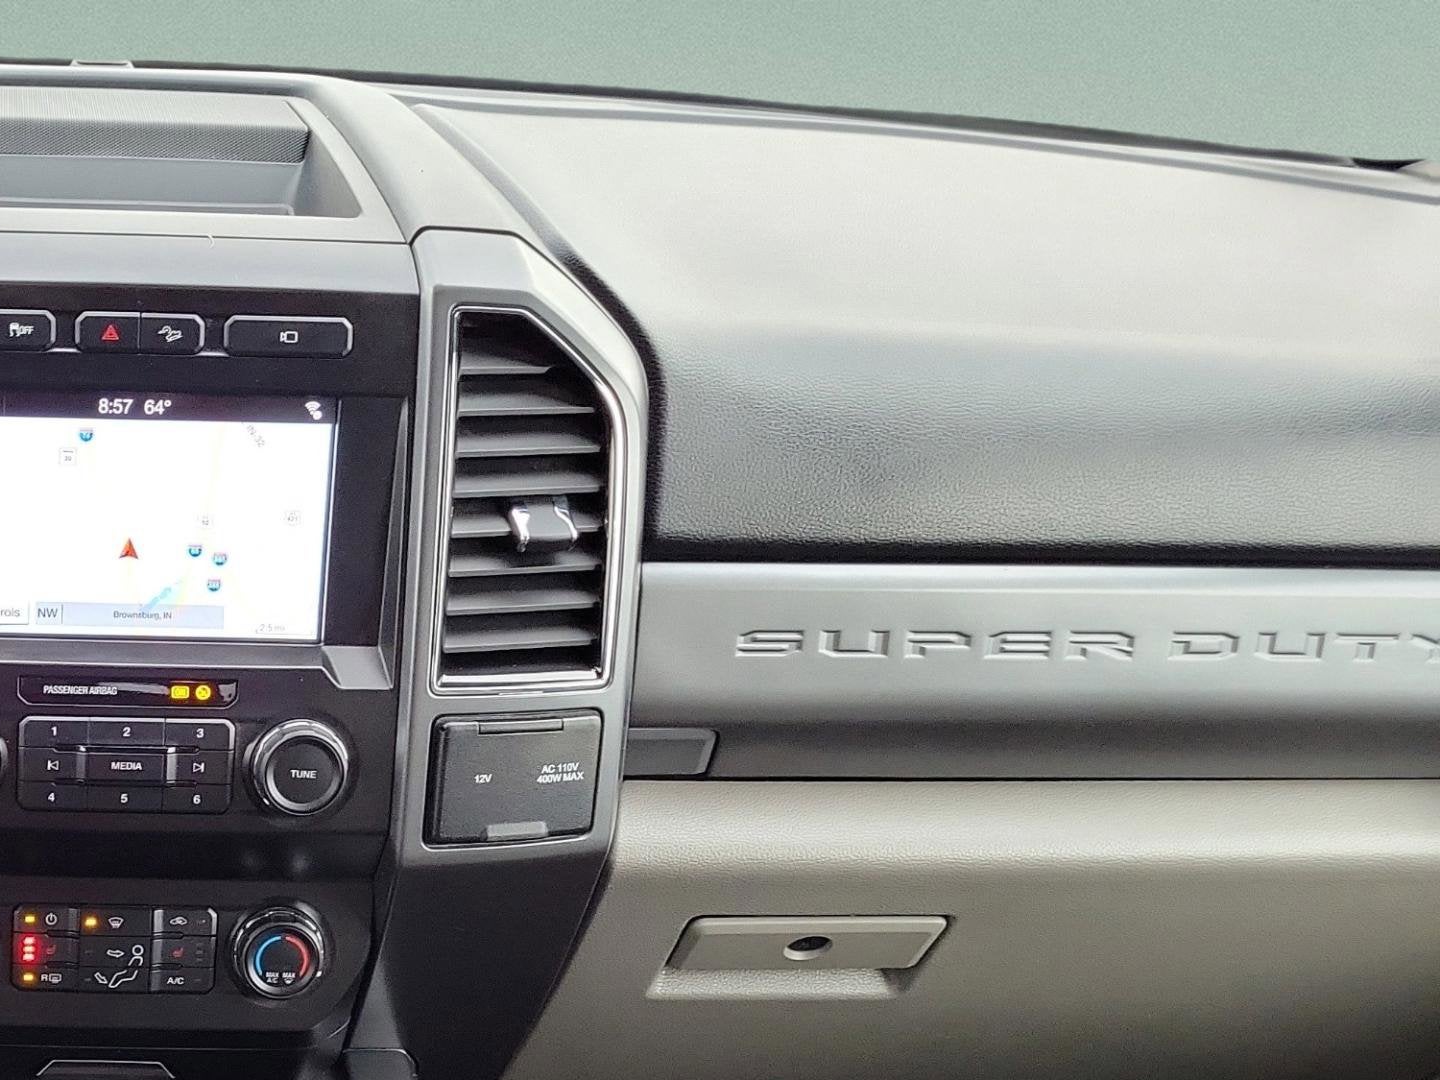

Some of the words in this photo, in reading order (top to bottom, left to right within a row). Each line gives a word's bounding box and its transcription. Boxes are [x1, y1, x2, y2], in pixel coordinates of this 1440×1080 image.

[98, 397, 134, 415] 8:57
[37, 608, 59, 619] NW
[734, 628, 1136, 661] SUPER
[43, 685, 88, 695] PASSENGER
[88, 686, 118, 696] AIRBAG
[50, 726, 58, 736] 1
[122, 727, 131, 737] 2
[196, 728, 204, 738] 3
[111, 761, 143, 770] MEDIA
[541, 764, 556, 774] AC
[557, 762, 580, 773] 110V
[290, 769, 317, 779] TUNE
[473, 773, 493, 784] 12V
[536, 773, 562, 784] 400W
[562, 771, 585, 782] MAX
[47, 792, 56, 802] 4
[120, 794, 129, 803] 5
[193, 795, 201, 804] 6
[166, 976, 185, 986] A/C
